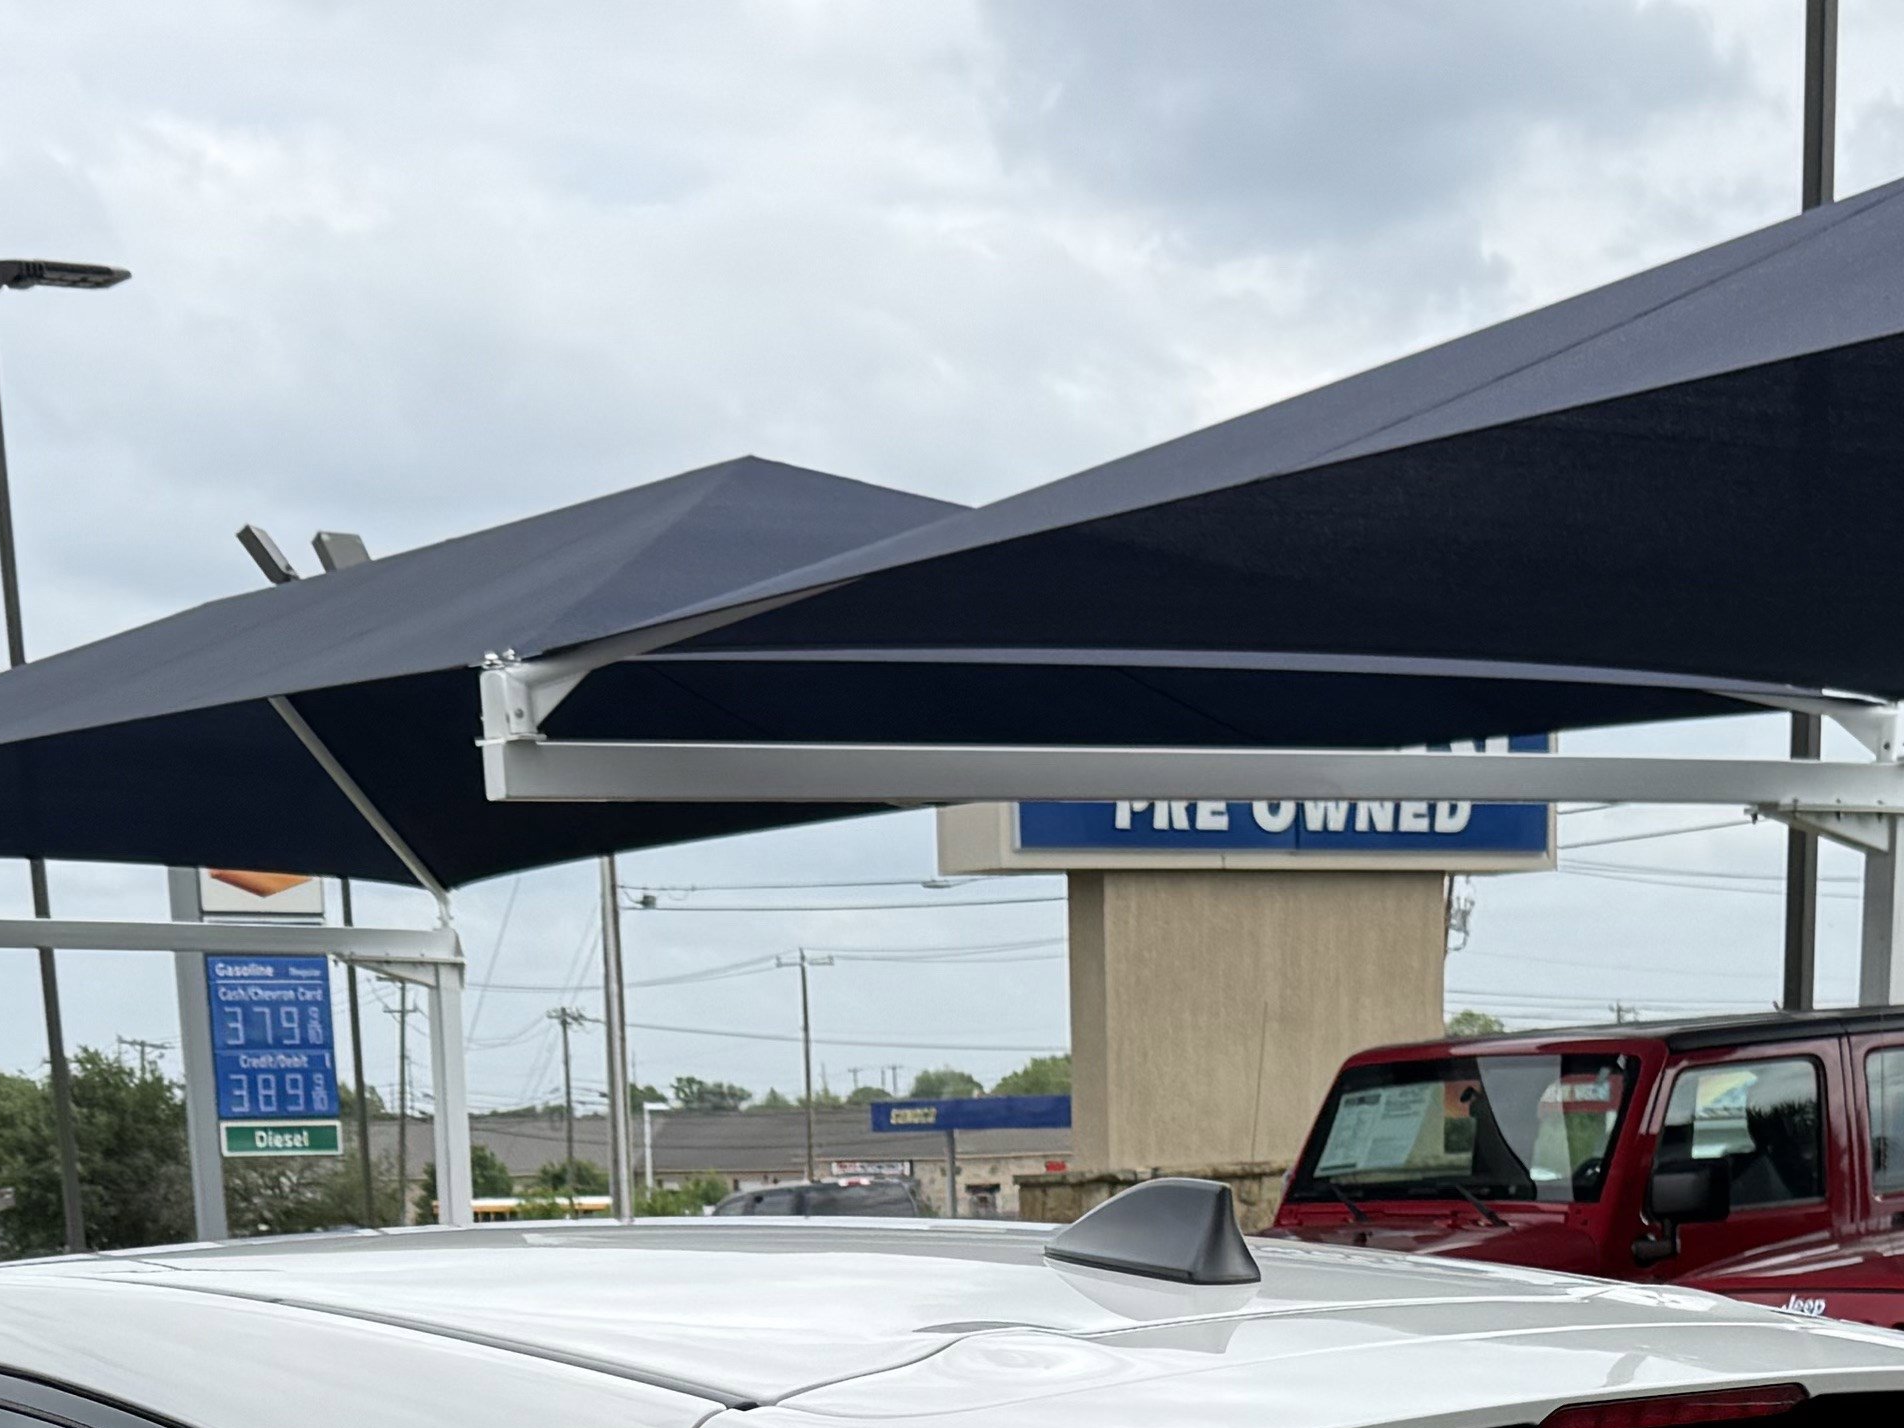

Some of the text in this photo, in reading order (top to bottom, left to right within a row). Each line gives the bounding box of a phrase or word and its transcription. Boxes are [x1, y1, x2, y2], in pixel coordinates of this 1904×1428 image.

[215, 963, 274, 977] Gasoline
[297, 985, 323, 1001] Card
[239, 1053, 308, 1068] Credit/Debit
[255, 1130, 309, 1148] Diesel
[1782, 1294, 1826, 1316] Jeep
